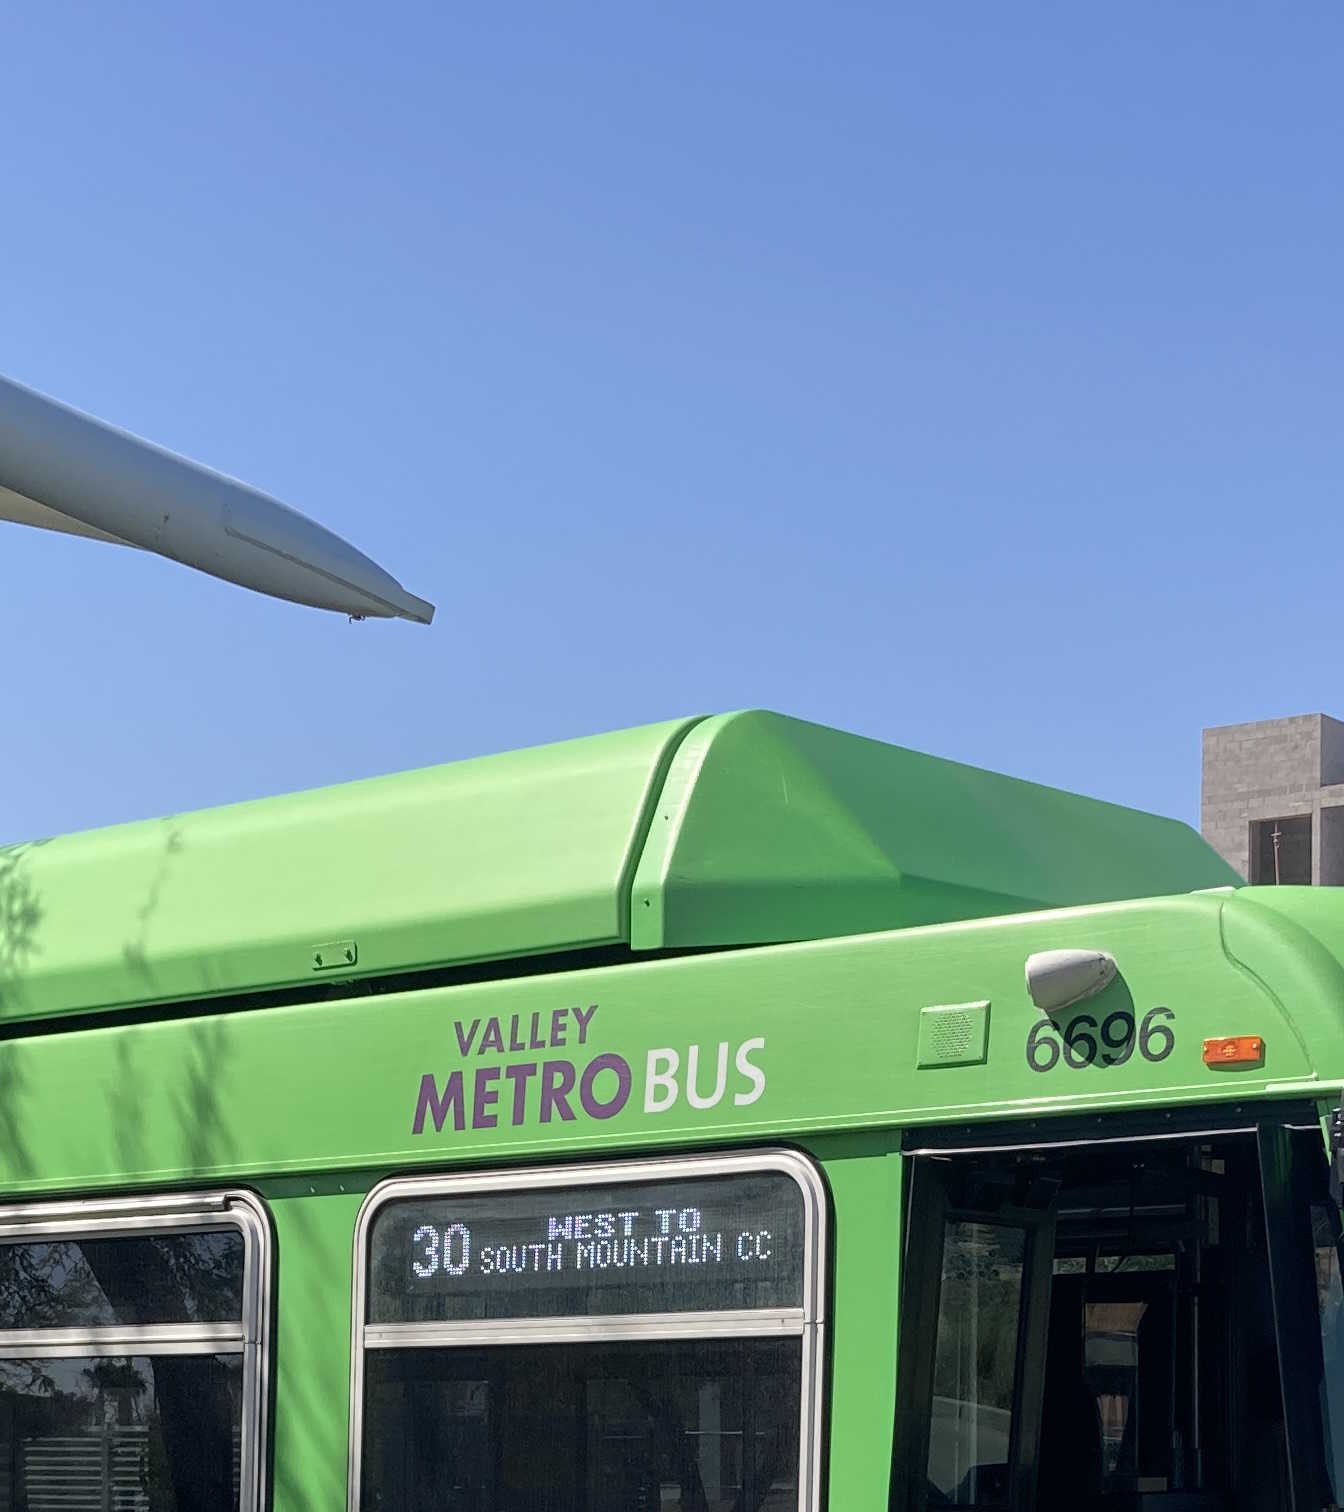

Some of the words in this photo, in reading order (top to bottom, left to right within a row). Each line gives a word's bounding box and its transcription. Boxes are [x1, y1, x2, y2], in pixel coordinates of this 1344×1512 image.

[453, 1004, 599, 1057] VALLEY
[1026, 1006, 1176, 1073] 6696
[547, 1210, 639, 1240] WEST
[654, 1207, 702, 1233] TO
[411, 1223, 472, 1278] 30
[479, 1242, 563, 1275] SOUTH
[576, 1232, 722, 1270] MOUNTAIN
[736, 1230, 773, 1262] CC
